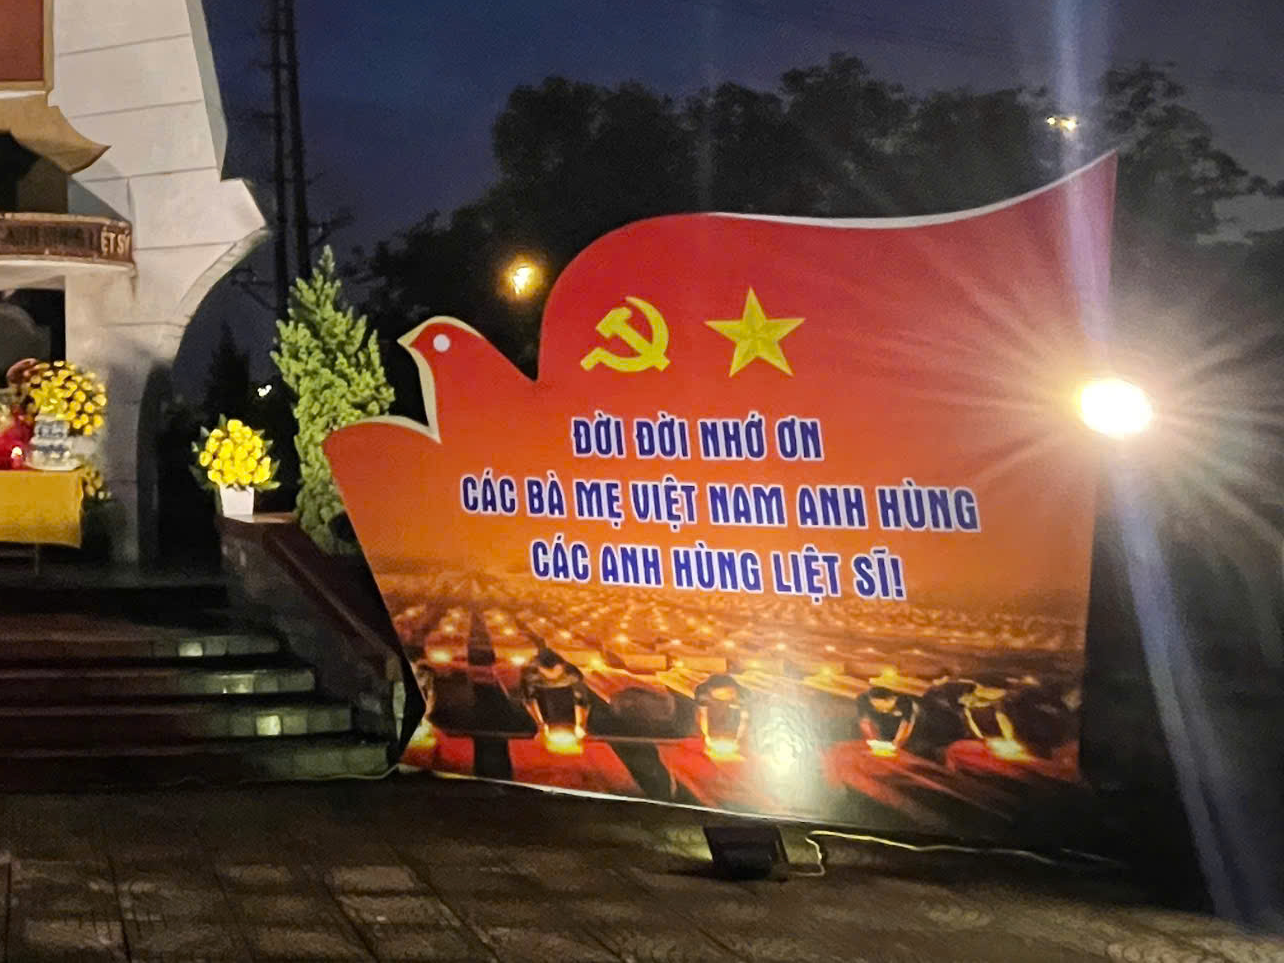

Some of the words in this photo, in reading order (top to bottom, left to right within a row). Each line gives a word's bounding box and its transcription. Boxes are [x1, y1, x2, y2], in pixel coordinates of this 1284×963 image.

[571, 409, 627, 458] ĐỜI
[633, 410, 691, 460] ĐỜI
[698, 410, 766, 461] NHỚ
[775, 415, 825, 461] ƠN
[461, 467, 518, 515] CÁC
[525, 469, 566, 517] BÀ
[573, 480, 625, 530] MẸ
[629, 474, 698, 533] VIỆT
[707, 483, 788, 528] NAM
[797, 484, 869, 529] ANH
[876, 477, 982, 533] HÙNG
[530, 533, 591, 584] CÁC
[600, 543, 664, 588] ANH
[671, 540, 764, 593] HÙNG
[771, 543, 843, 605] LIỆT
[851, 546, 908, 601] SĨ!
